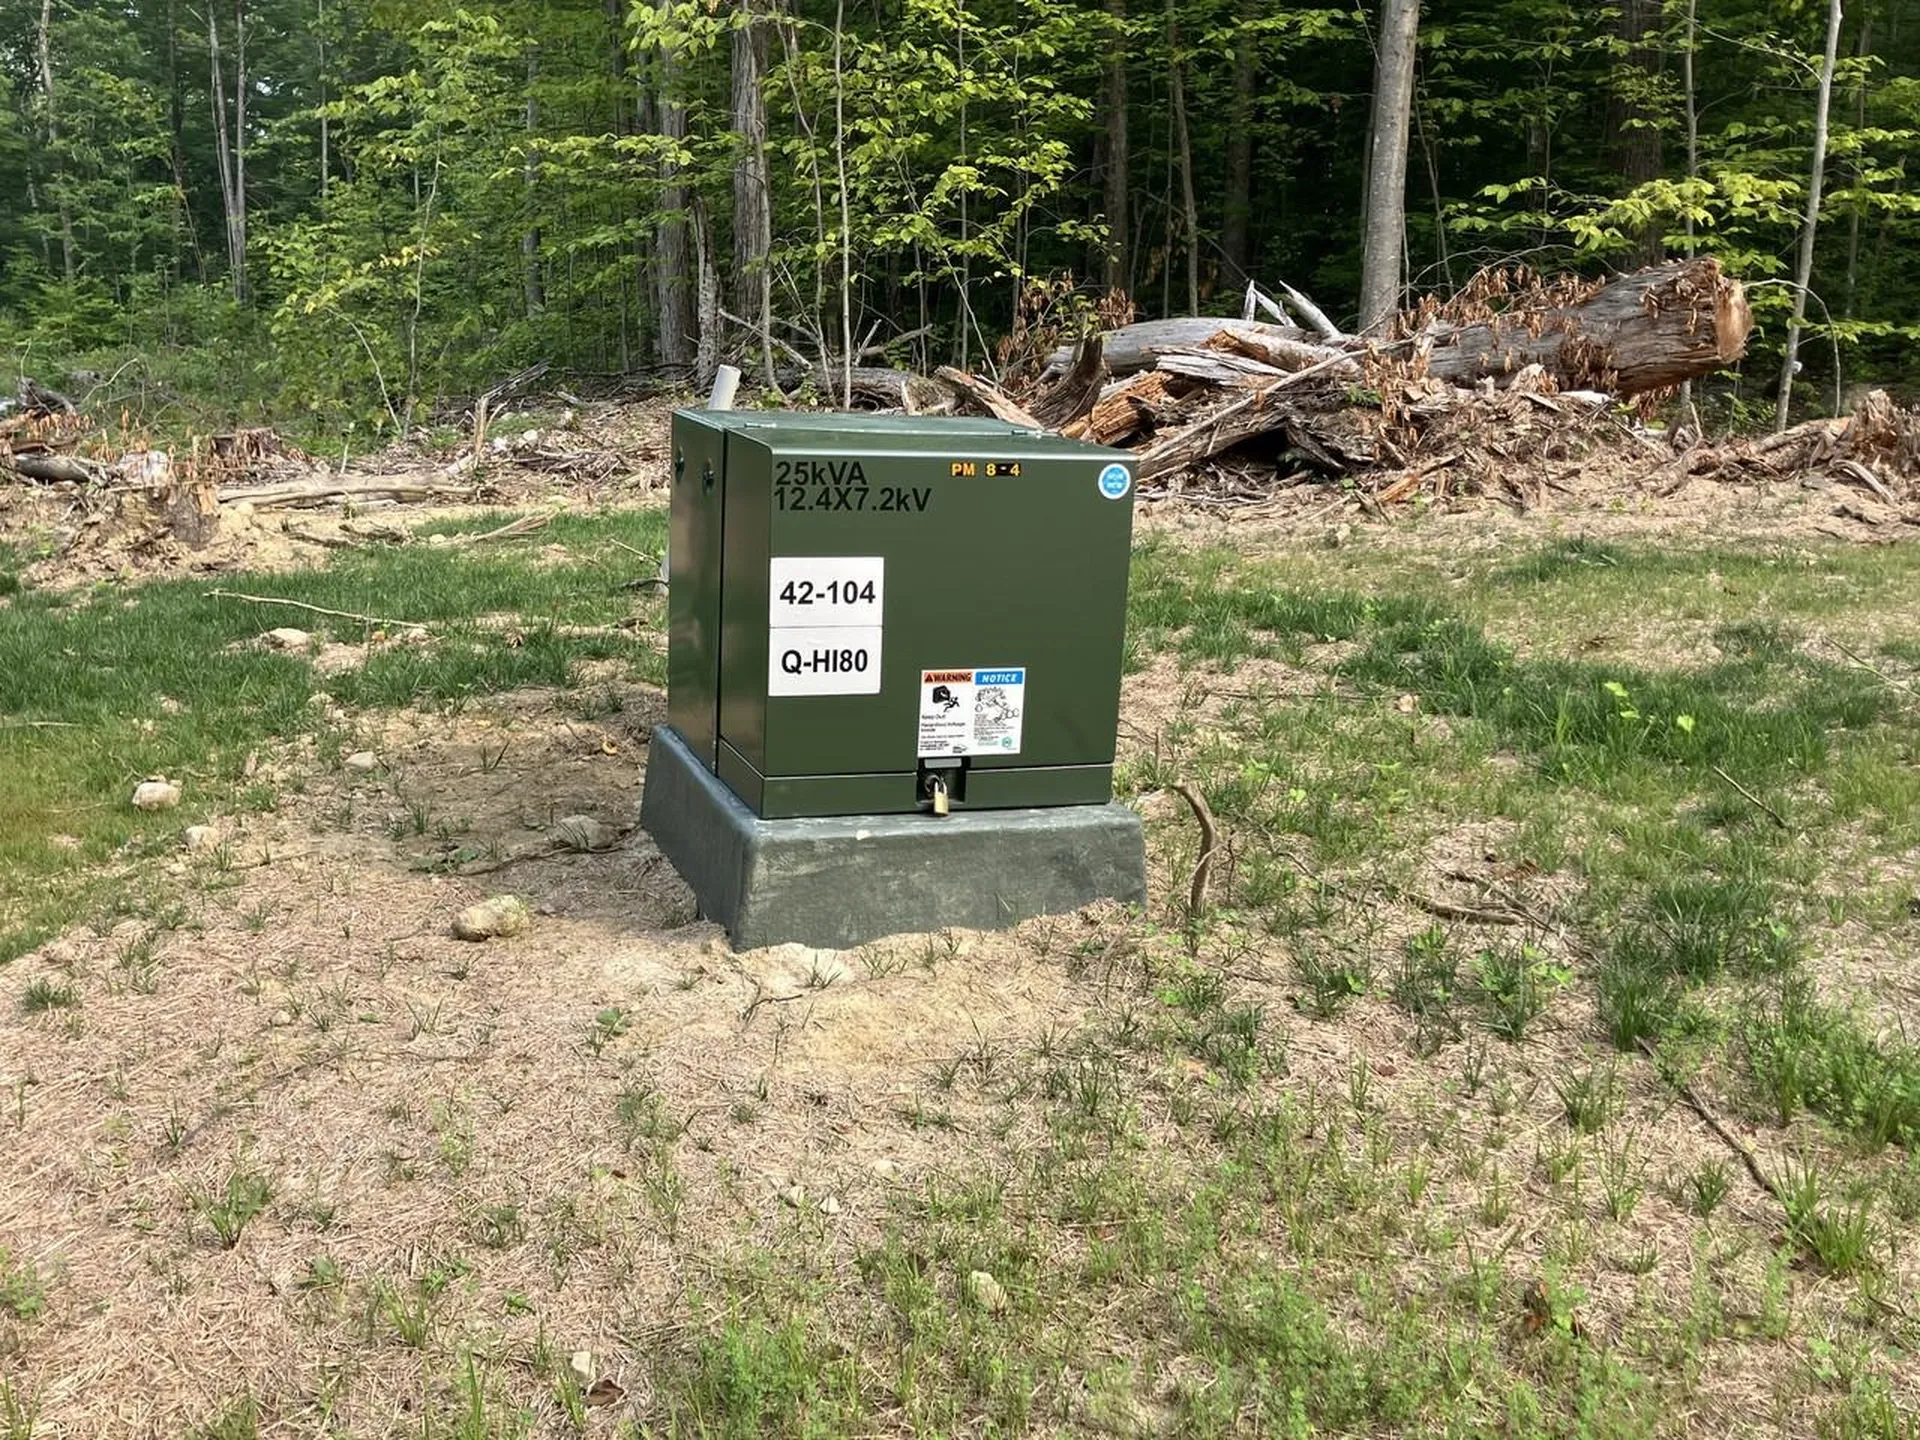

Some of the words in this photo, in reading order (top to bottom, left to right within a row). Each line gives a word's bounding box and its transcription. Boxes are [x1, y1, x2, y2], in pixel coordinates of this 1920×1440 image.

[775, 461, 868, 486] 25kVA
[951, 462, 975, 477] PM
[774, 487, 932, 511] 12.4X7.2kV
[780, 580, 876, 605] 42-104
[781, 648, 868, 675] Q-HI80
[934, 672, 972, 682] WARNING
[982, 673, 1017, 683] NOTICE
